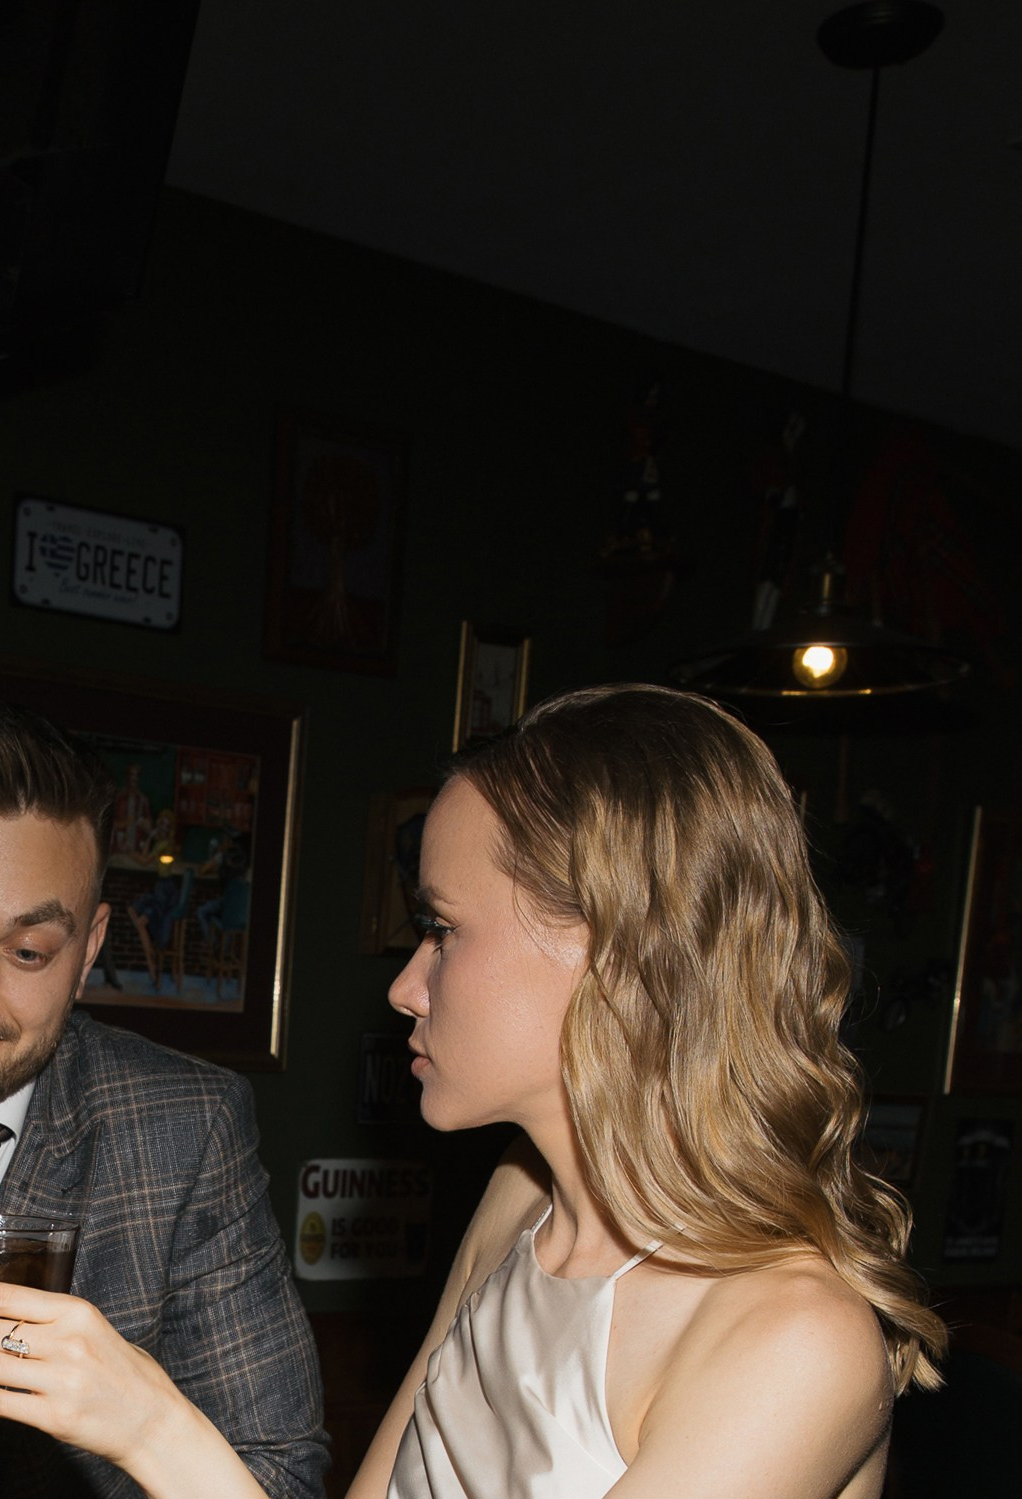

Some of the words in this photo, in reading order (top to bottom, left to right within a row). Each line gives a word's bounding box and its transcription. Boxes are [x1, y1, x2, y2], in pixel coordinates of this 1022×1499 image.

[75, 540, 174, 600] GREECE
[301, 1165, 429, 1200] GUINNESS
[332, 1217, 346, 1237] IS
